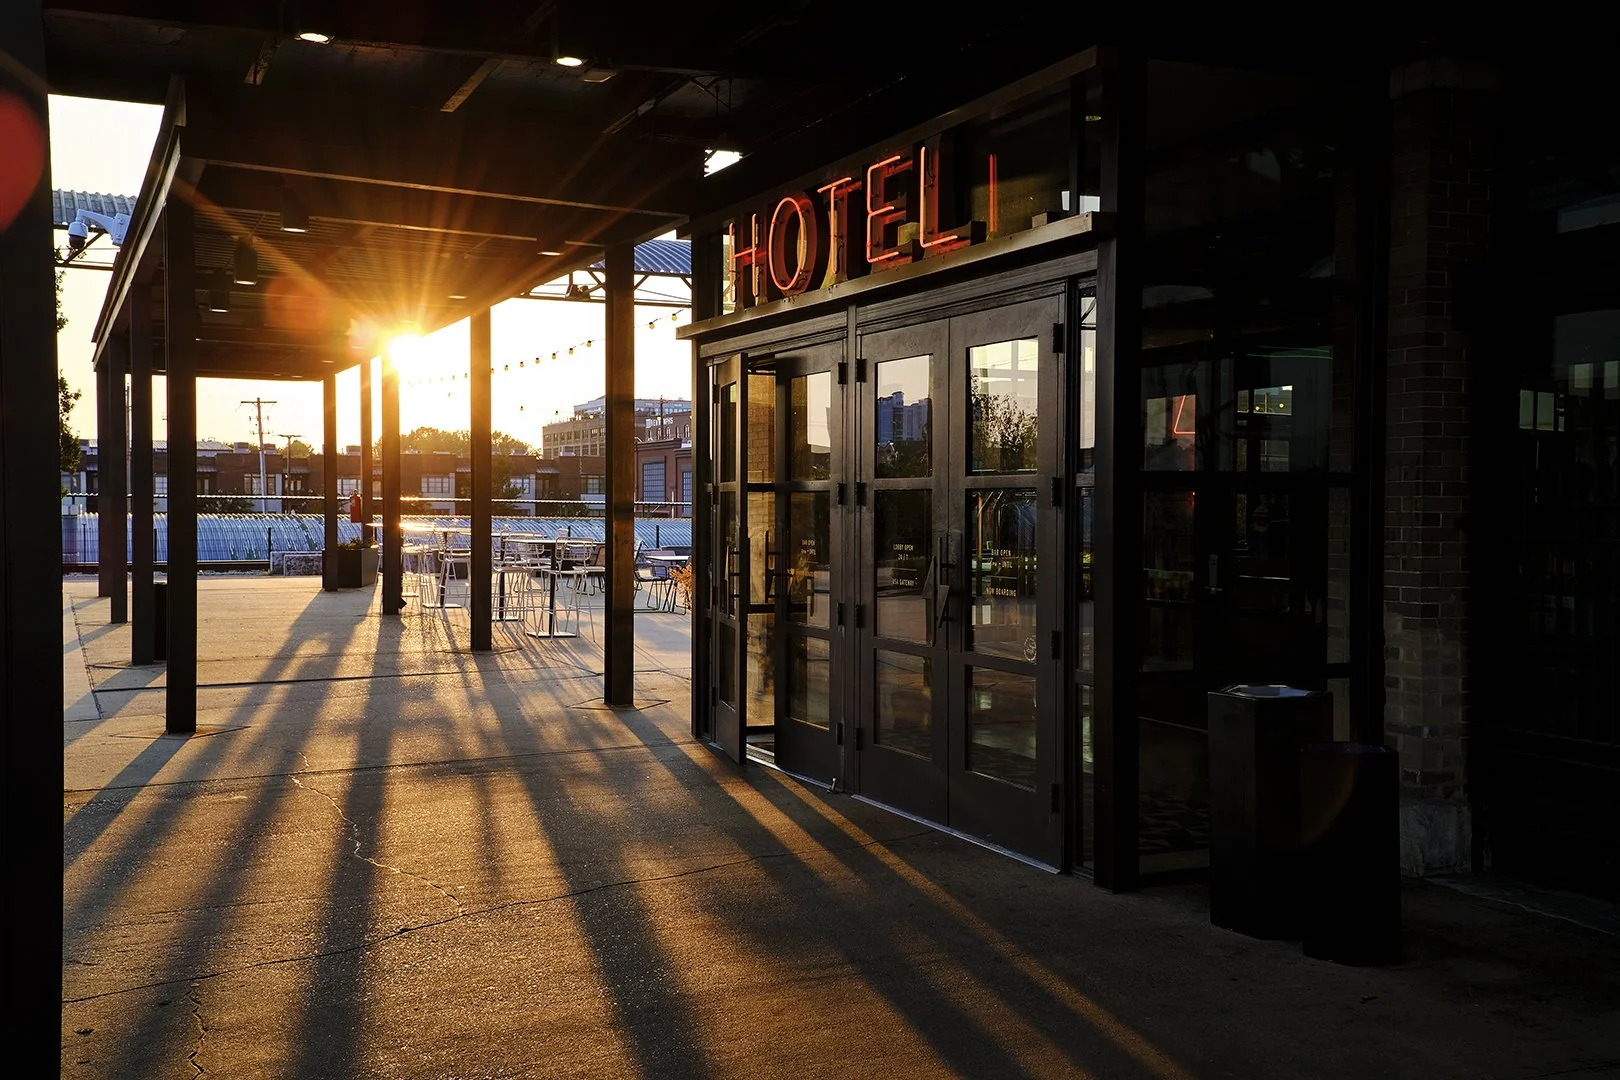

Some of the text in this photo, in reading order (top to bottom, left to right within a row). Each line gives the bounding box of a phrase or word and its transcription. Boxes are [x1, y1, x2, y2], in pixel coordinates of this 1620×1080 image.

[728, 137, 973, 311] HOTEL
[904, 544, 914, 552] OPEN
[1000, 549, 1011, 557] OPEN
[995, 587, 1017, 597] BOARDING
